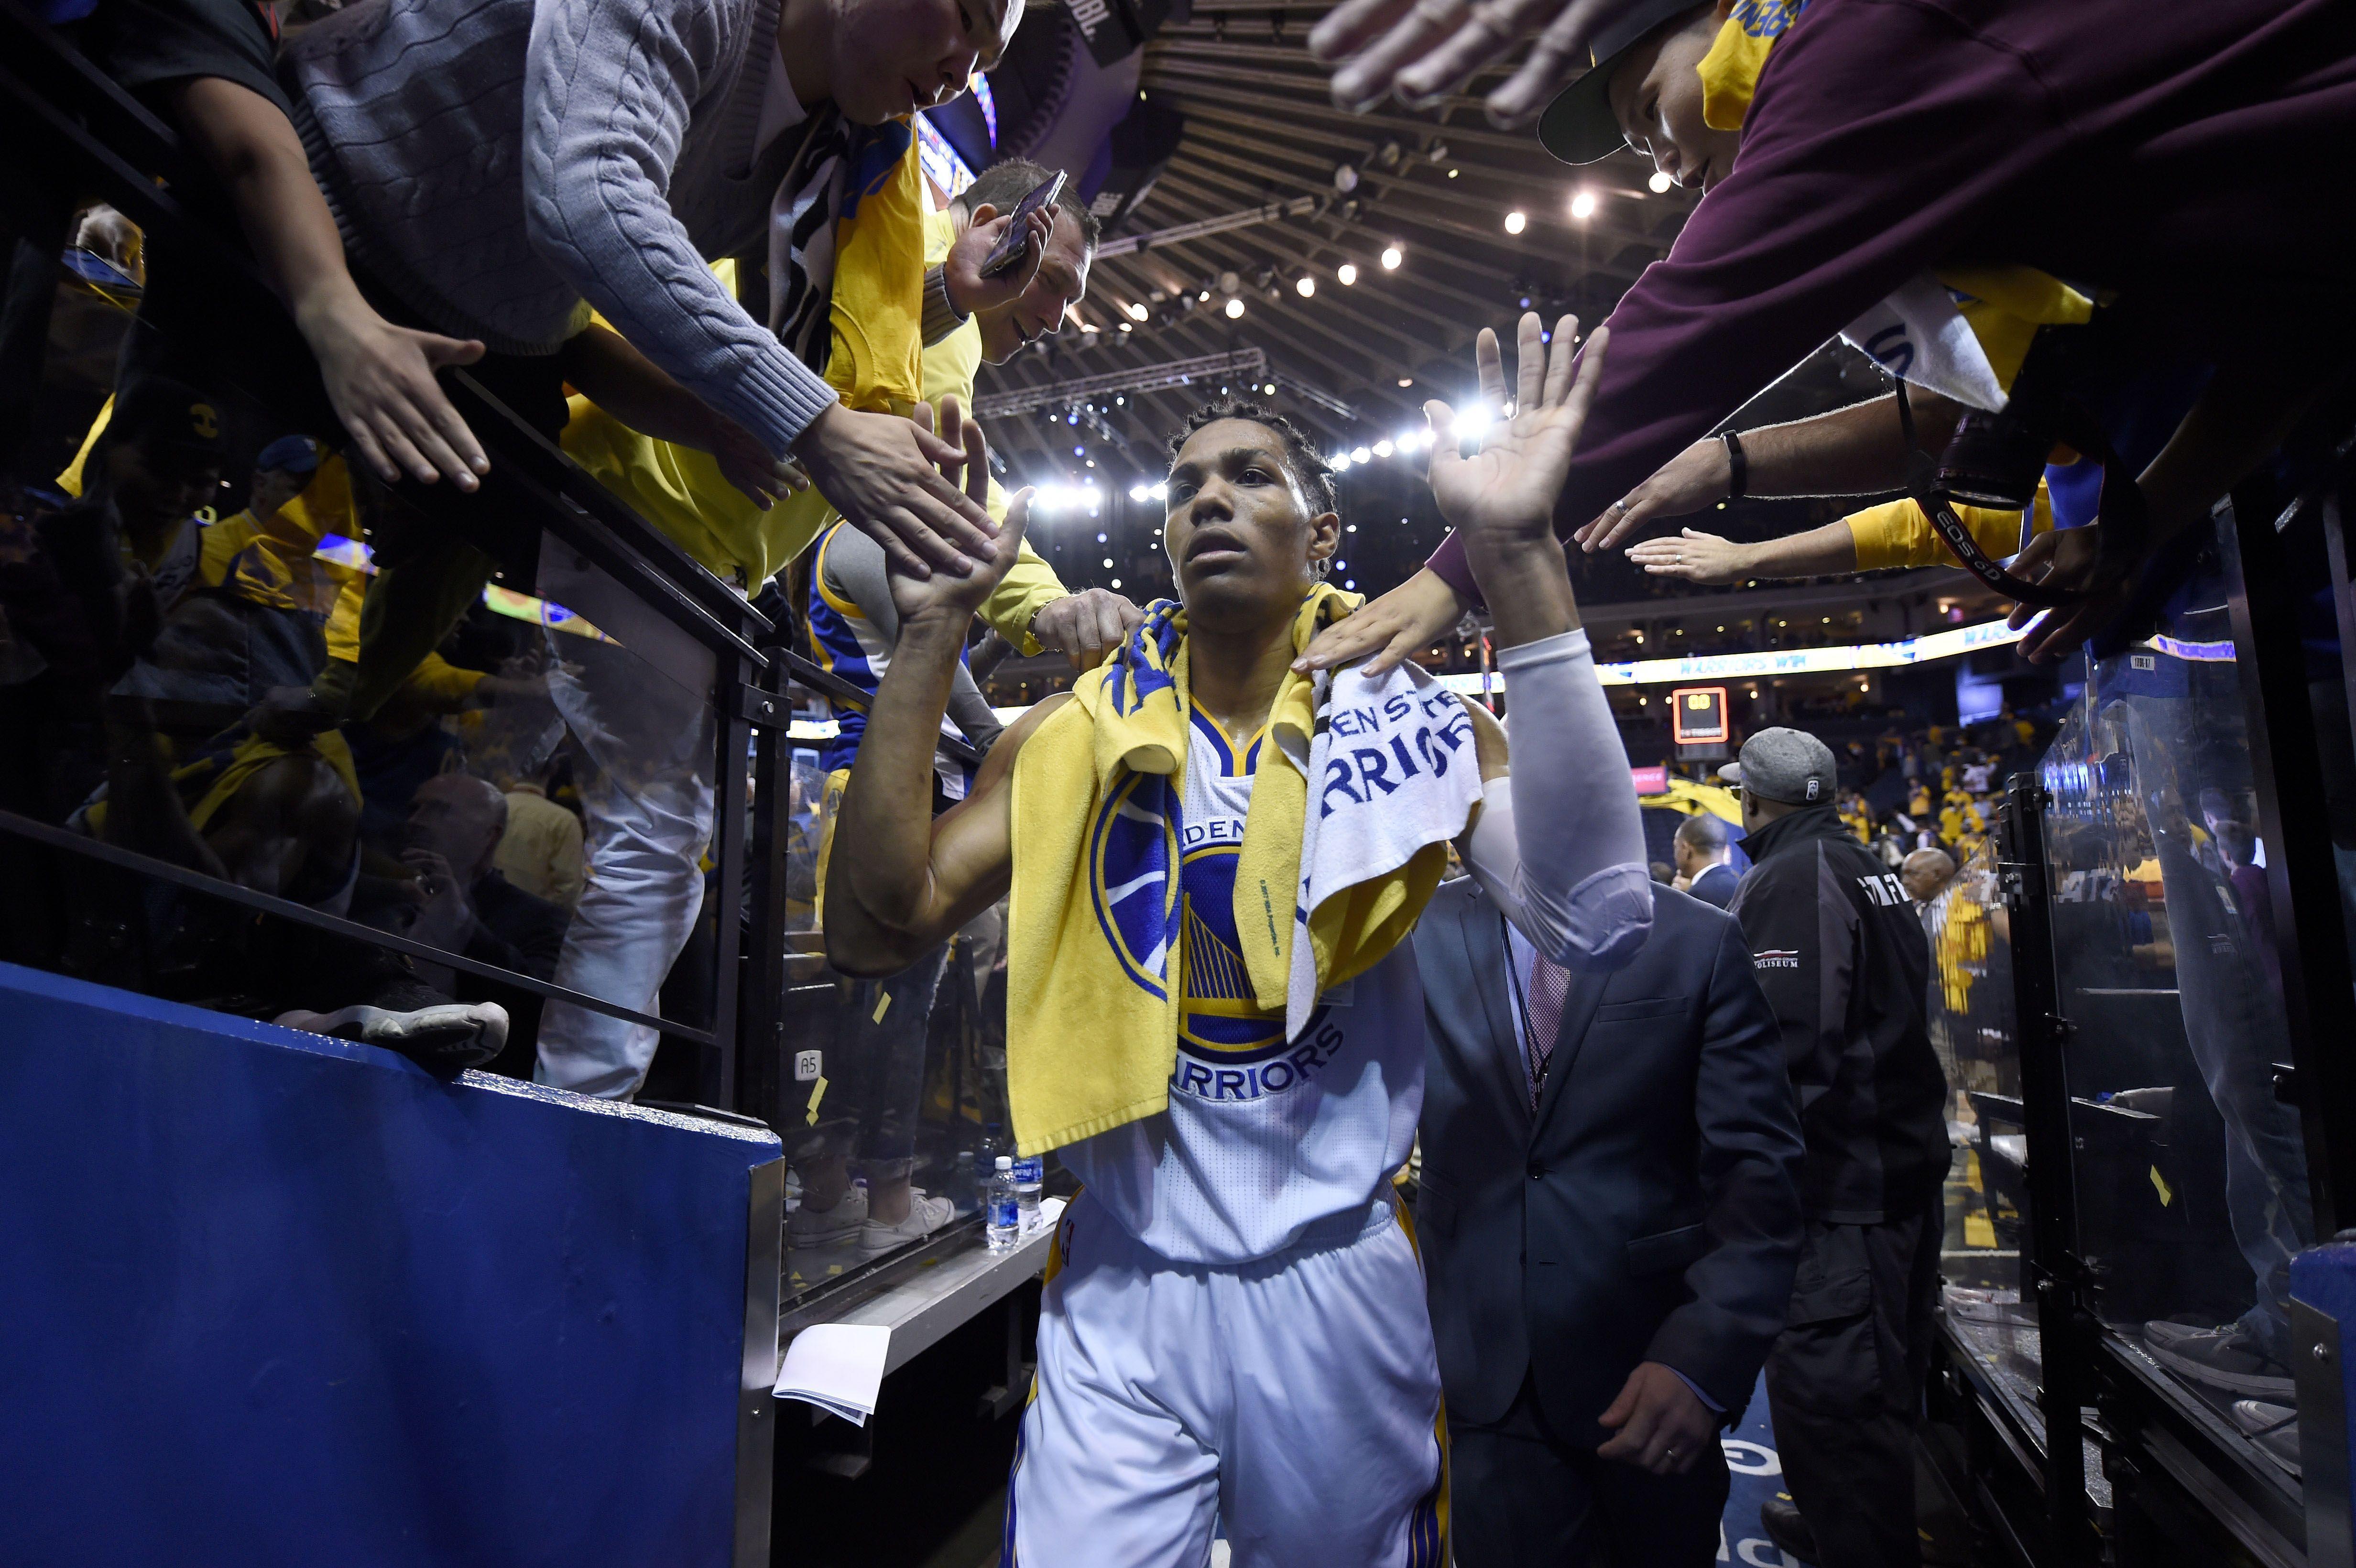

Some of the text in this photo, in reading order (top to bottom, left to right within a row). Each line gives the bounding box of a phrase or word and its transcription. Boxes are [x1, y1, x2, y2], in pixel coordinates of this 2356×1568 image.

[1937, 511, 2000, 580] EOS 6D
[1680, 657, 1767, 674] WARRIORS
[1183, 820, 1244, 845] DEN
[801, 1057, 816, 1074] A5
[1175, 1023, 1344, 1100] RRIORS
